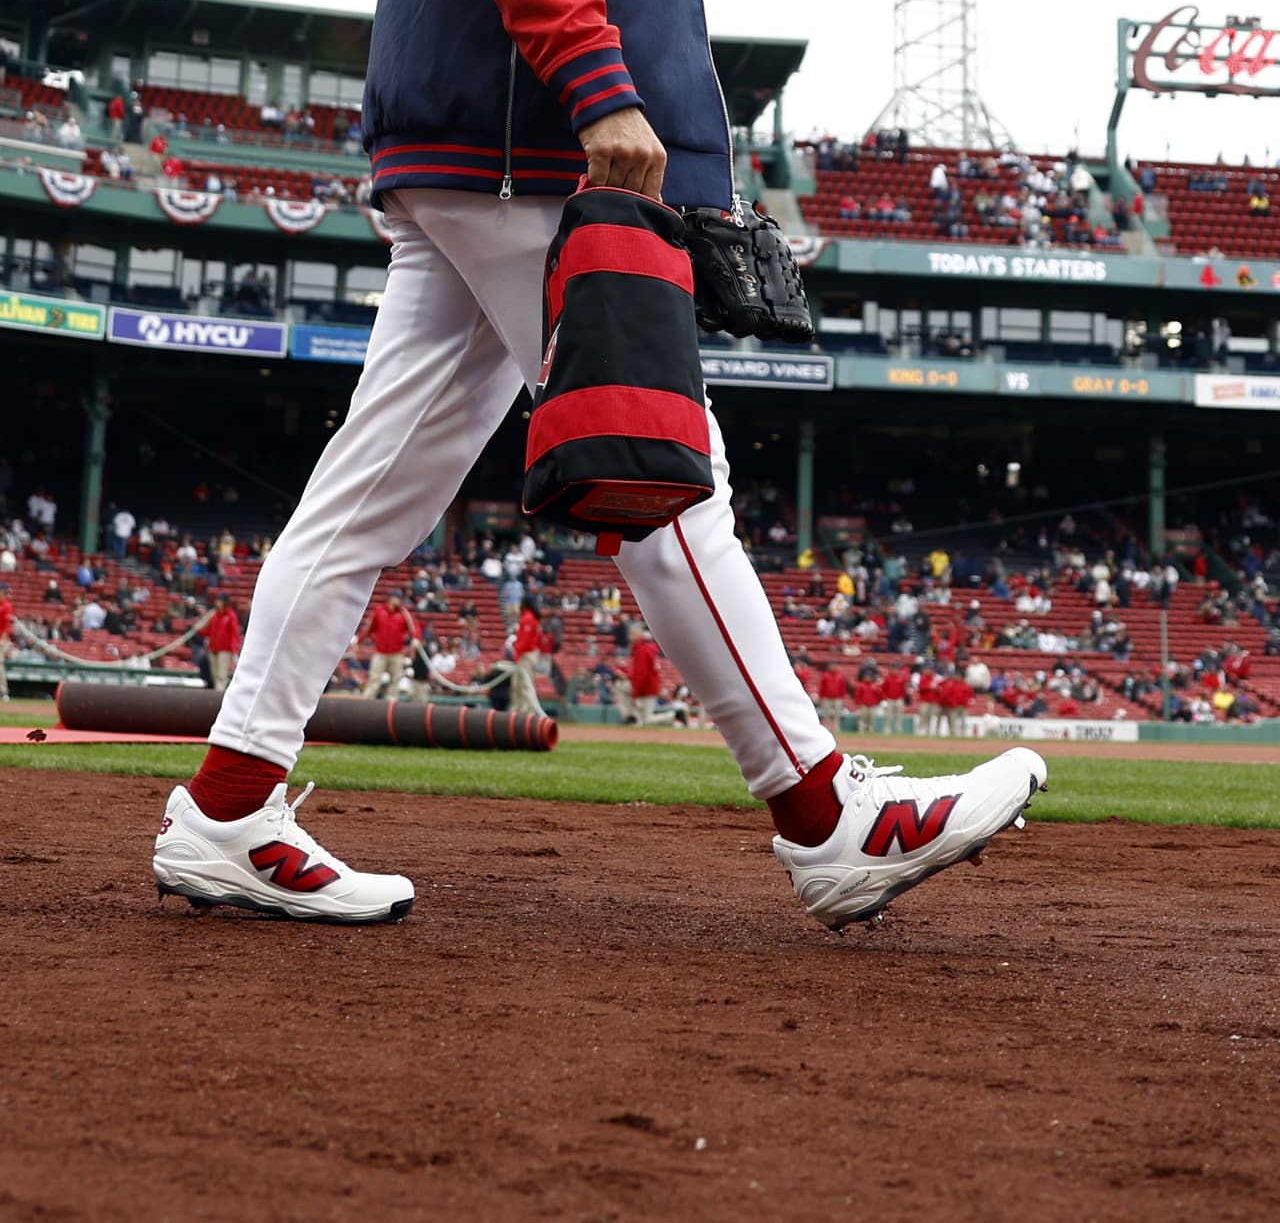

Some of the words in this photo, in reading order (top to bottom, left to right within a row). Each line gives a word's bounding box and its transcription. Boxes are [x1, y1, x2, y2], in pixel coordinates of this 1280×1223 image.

[928, 252, 1007, 276] TODAY'S
[1010, 257, 1106, 281] STARTERS
[173, 323, 248, 347] HYCU
[771, 362, 826, 380] VINES
[888, 369, 924, 385] KING
[1006, 371, 1029, 390] VS
[1072, 376, 1113, 393] GRAY
[860, 793, 964, 857] N
[248, 840, 341, 893] N
